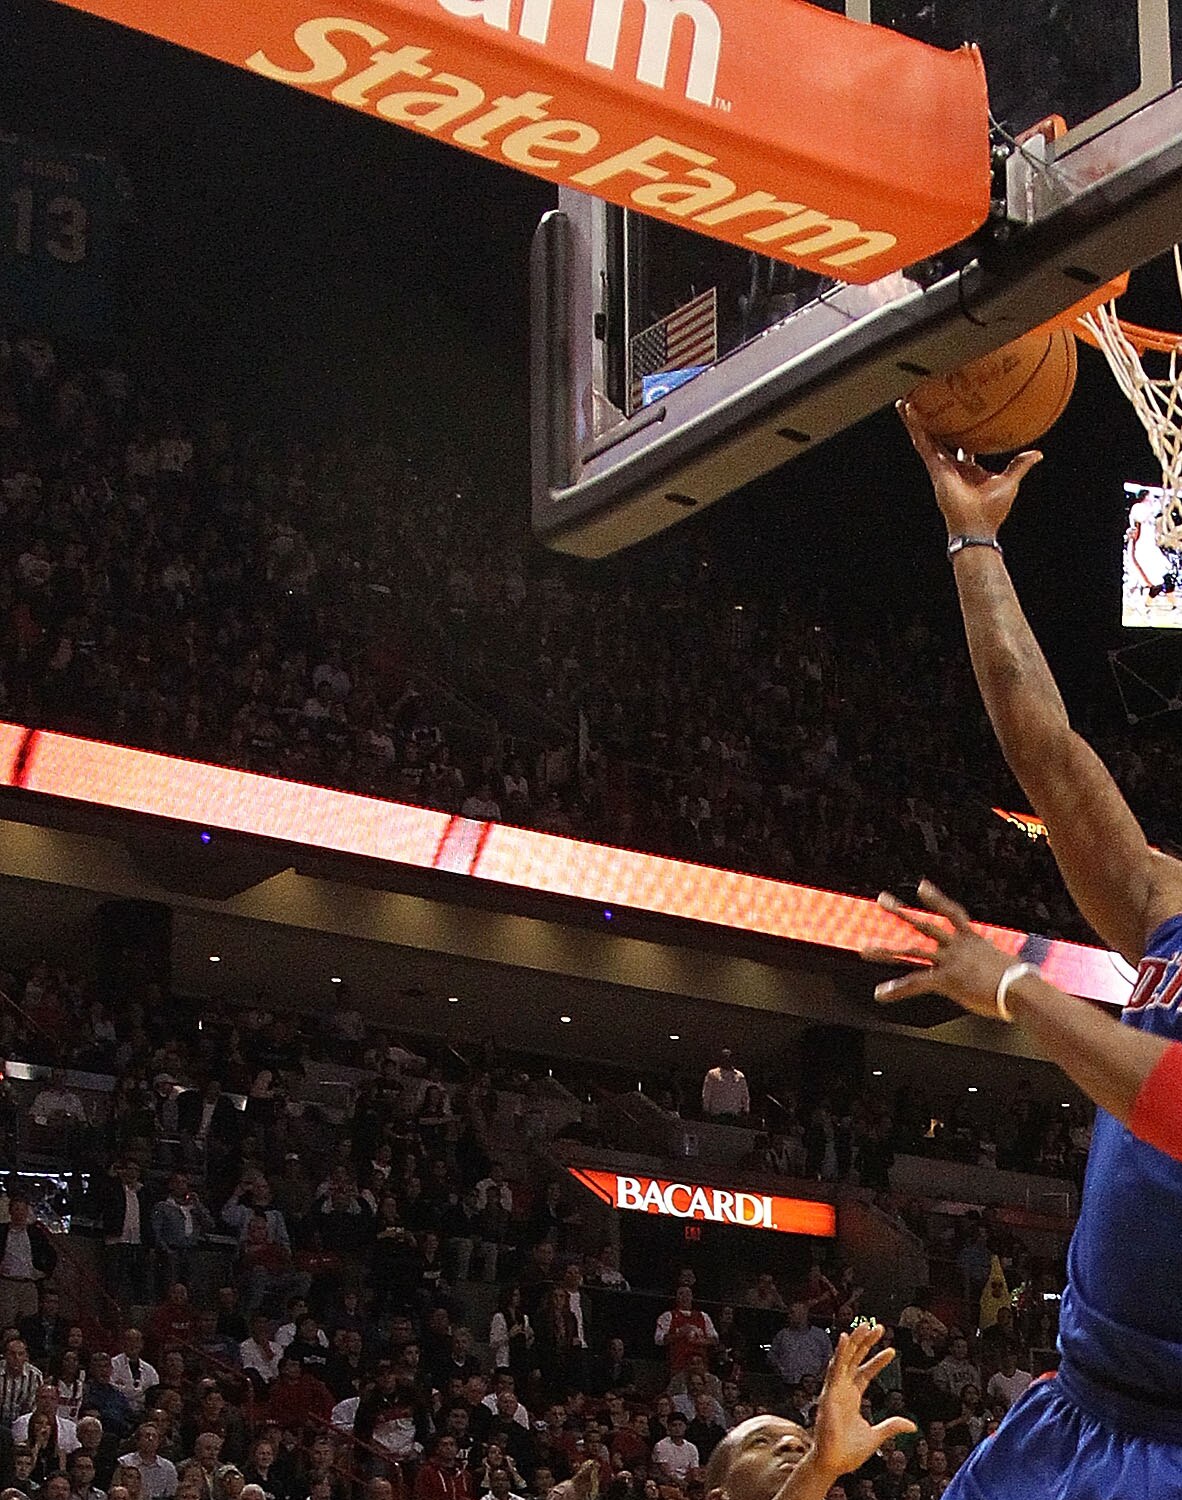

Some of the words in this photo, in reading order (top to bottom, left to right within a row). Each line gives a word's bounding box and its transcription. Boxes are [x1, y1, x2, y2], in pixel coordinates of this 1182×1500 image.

[243, 15, 600, 169] State
[568, 134, 898, 268] Farm
[615, 1175, 778, 1229] BACARDI
